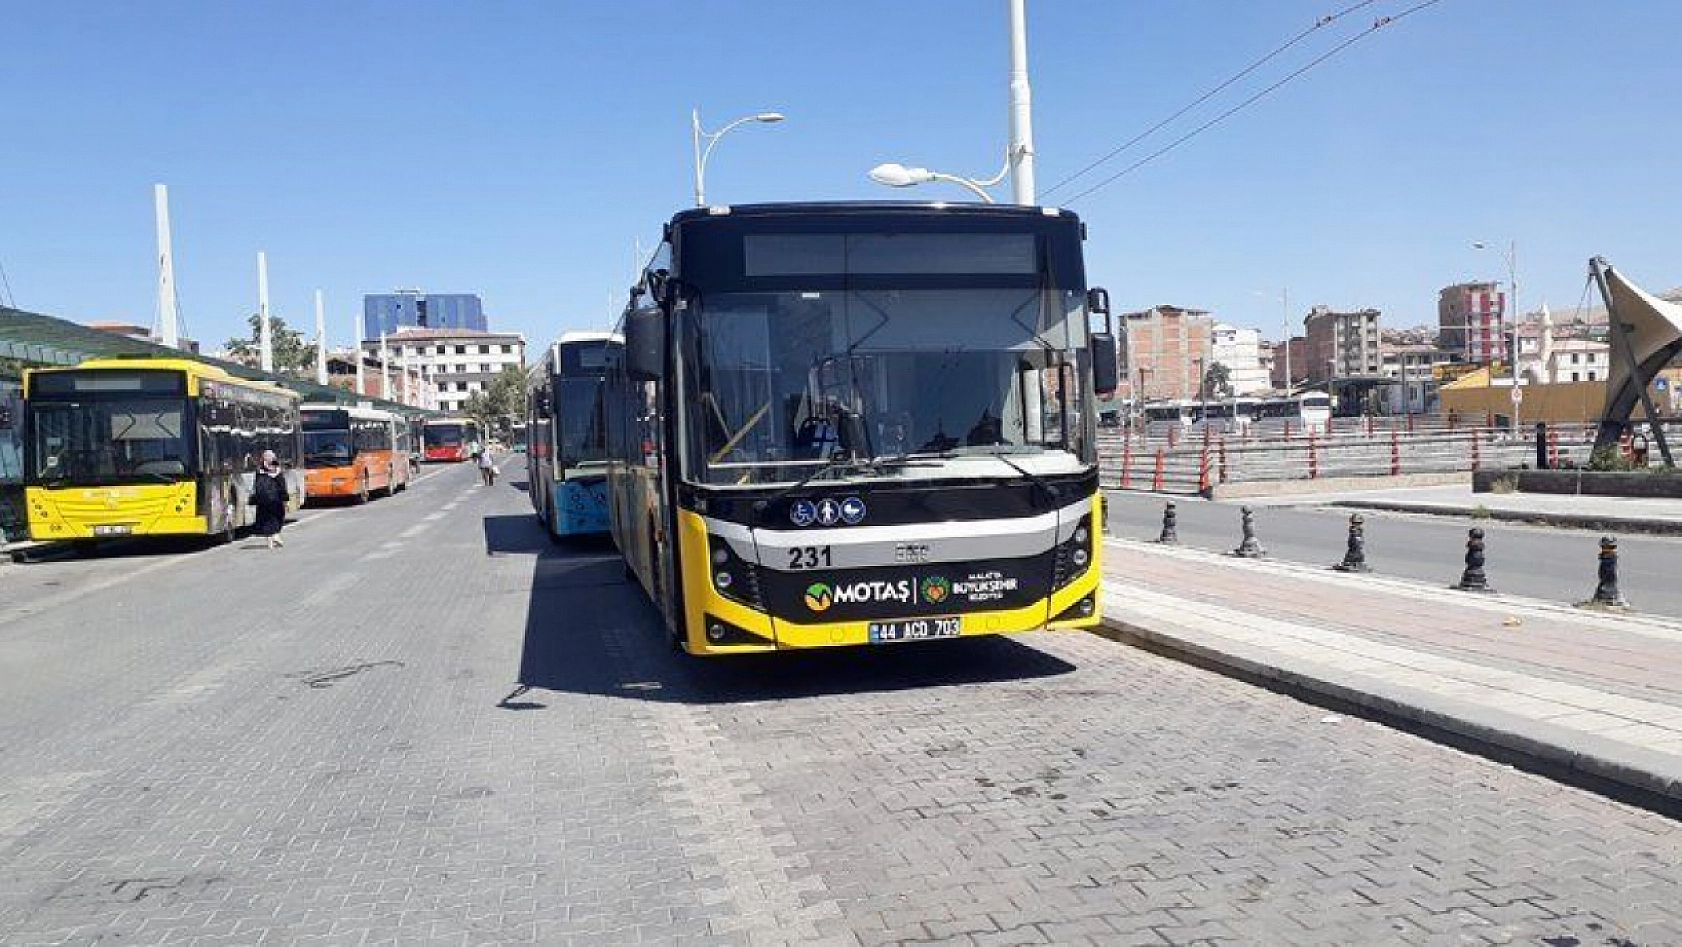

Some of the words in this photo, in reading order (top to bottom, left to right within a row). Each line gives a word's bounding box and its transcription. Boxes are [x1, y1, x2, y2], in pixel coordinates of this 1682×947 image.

[788, 545, 832, 569] 231
[834, 580, 910, 603] MOTAŞ
[880, 624, 896, 638] 44
[934, 618, 960, 637] 703
